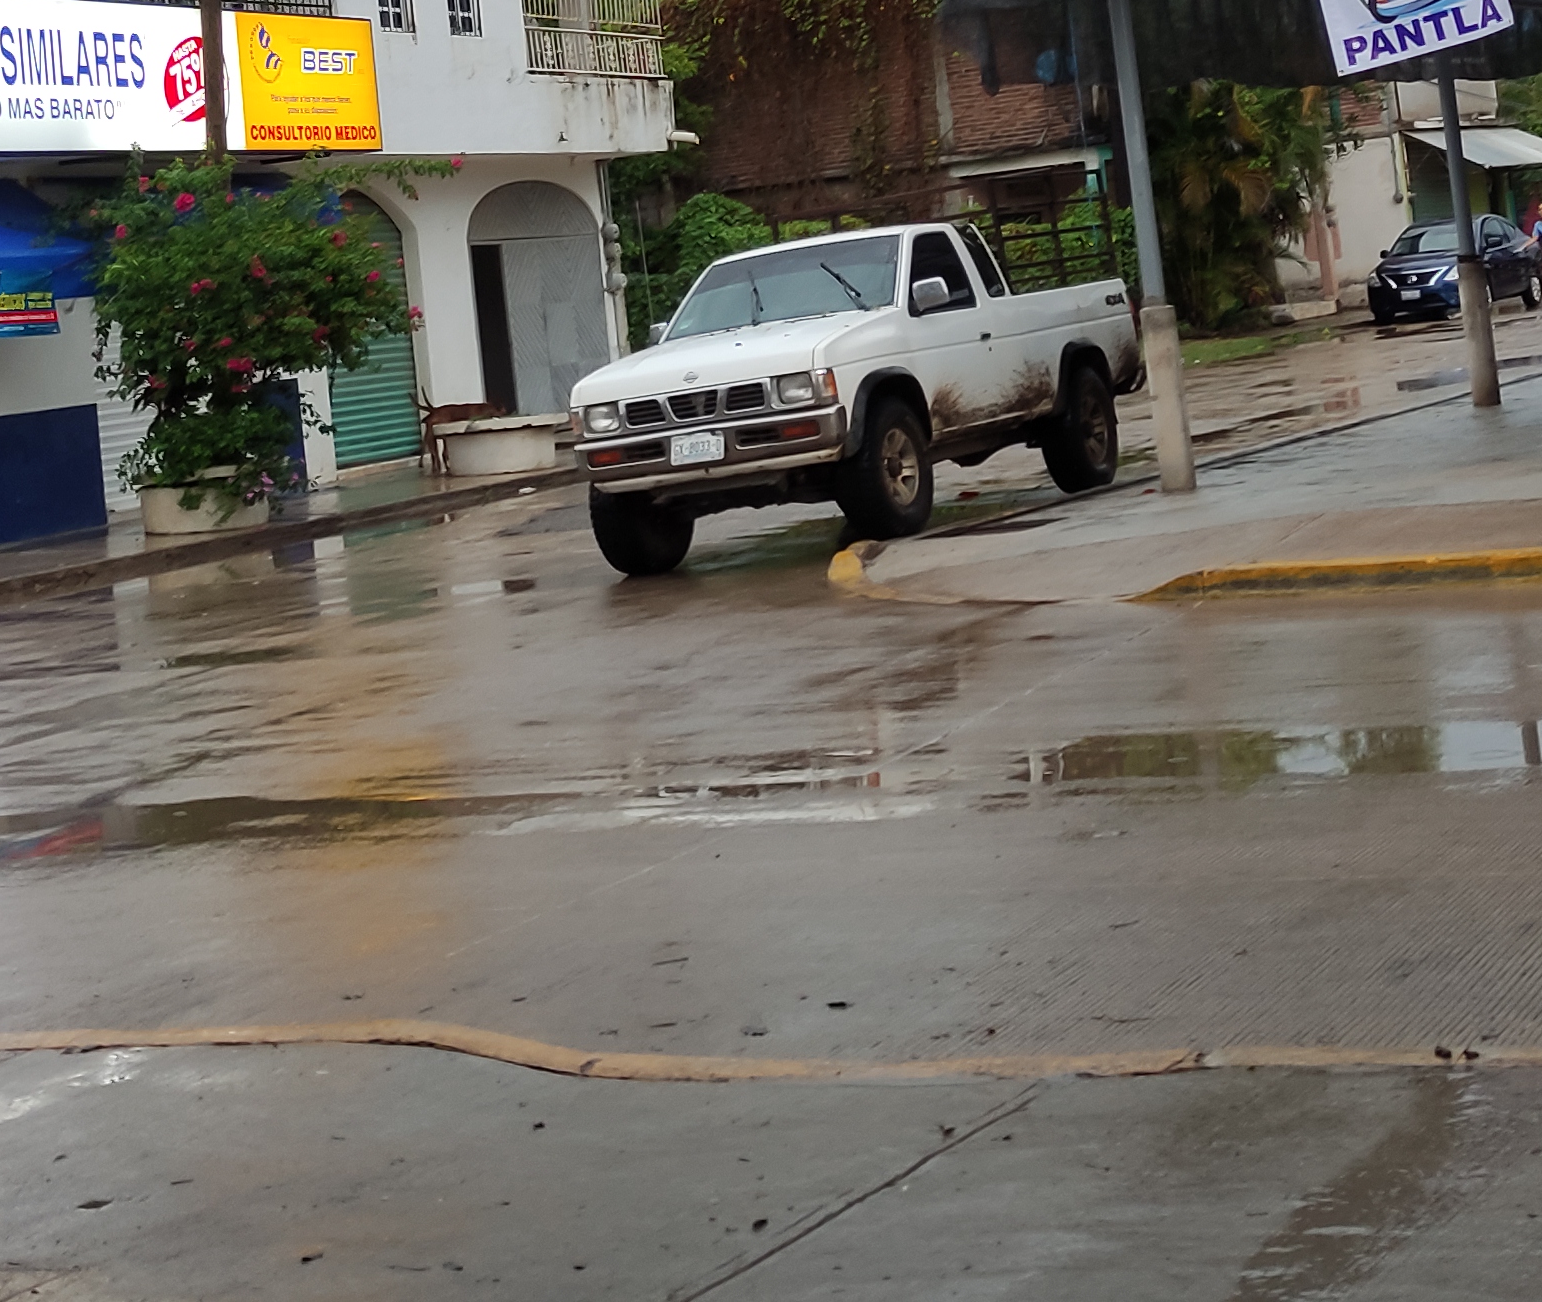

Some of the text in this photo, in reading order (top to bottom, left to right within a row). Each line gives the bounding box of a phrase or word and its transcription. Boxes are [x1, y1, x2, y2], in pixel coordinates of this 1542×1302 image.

[0, 25, 146, 90] SIMILARES
[172, 39, 198, 62] HASTA
[302, 49, 358, 74] BEST
[8, 97, 45, 120] MAS
[250, 124, 377, 141] CONSULTORIO MEDICO
